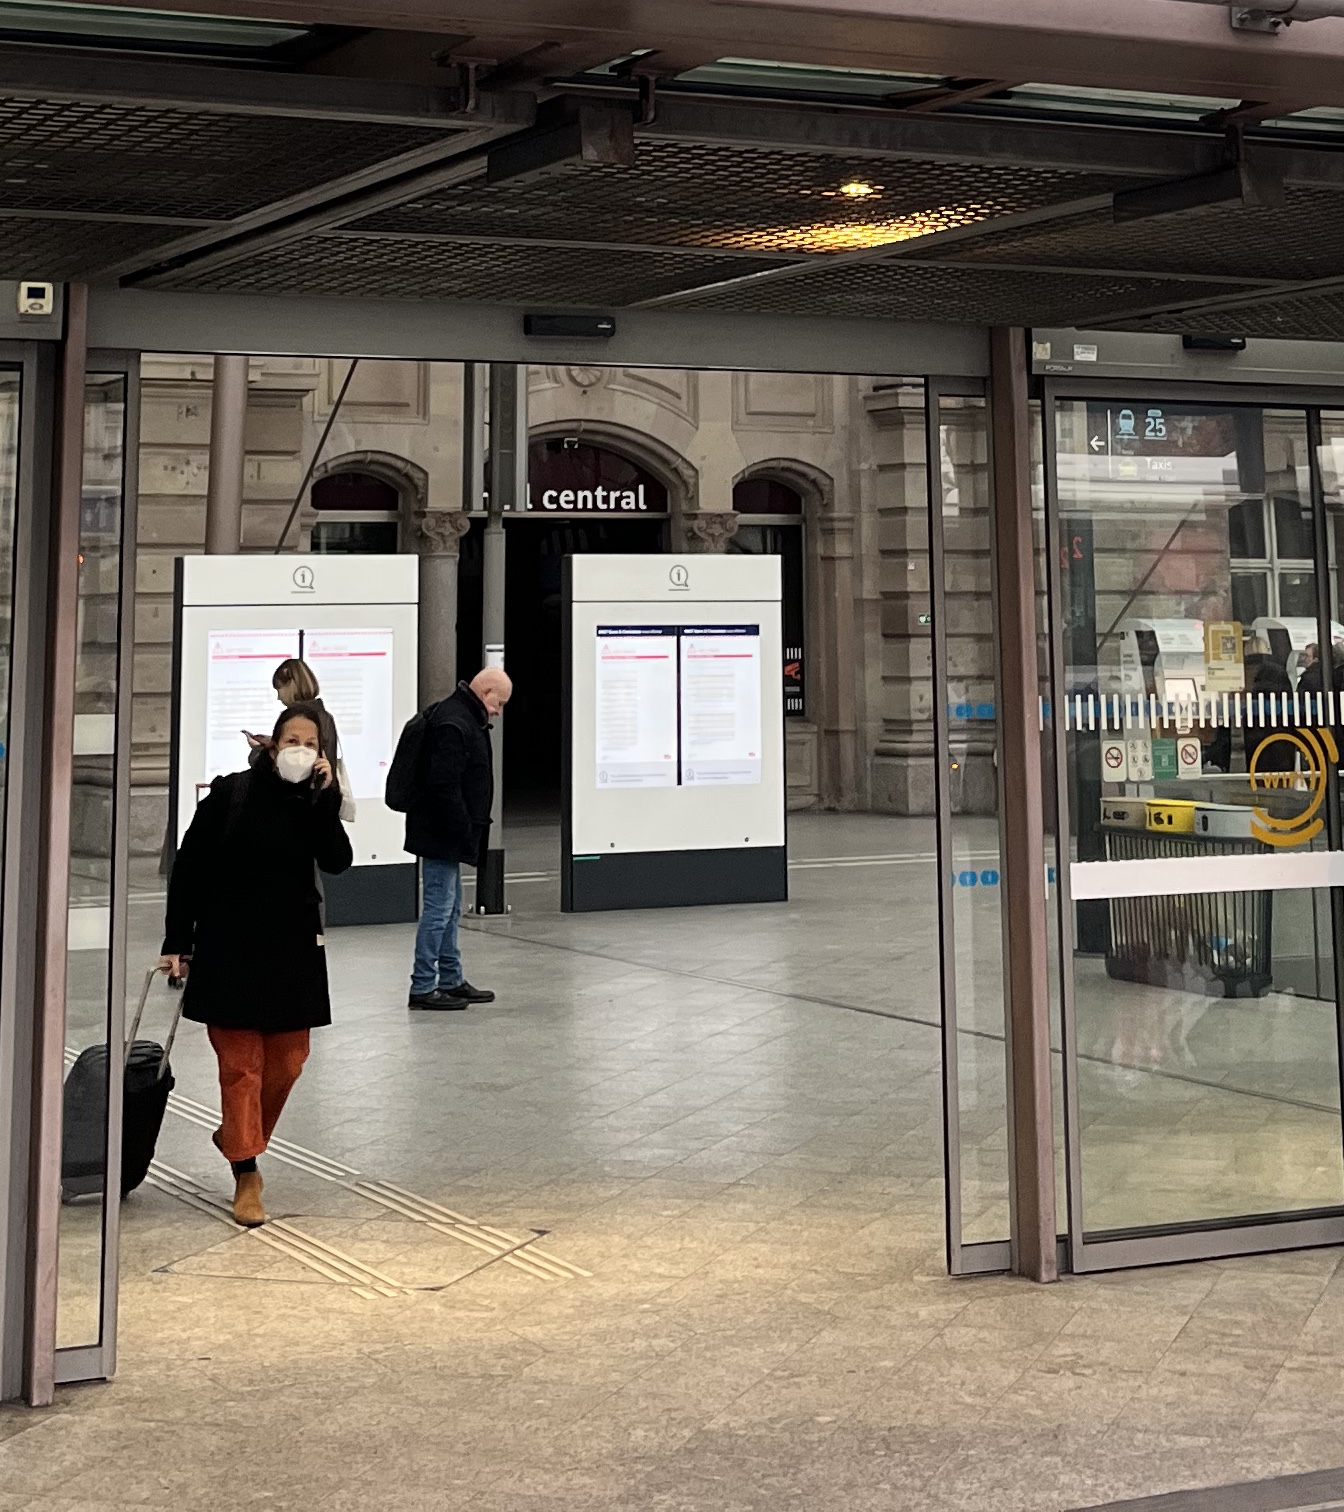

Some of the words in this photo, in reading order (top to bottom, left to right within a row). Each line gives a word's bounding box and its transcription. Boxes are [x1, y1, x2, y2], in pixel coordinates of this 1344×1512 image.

[1144, 417, 1167, 437] 25
[1145, 457, 1173, 471] Taxis
[542, 484, 648, 511] central
